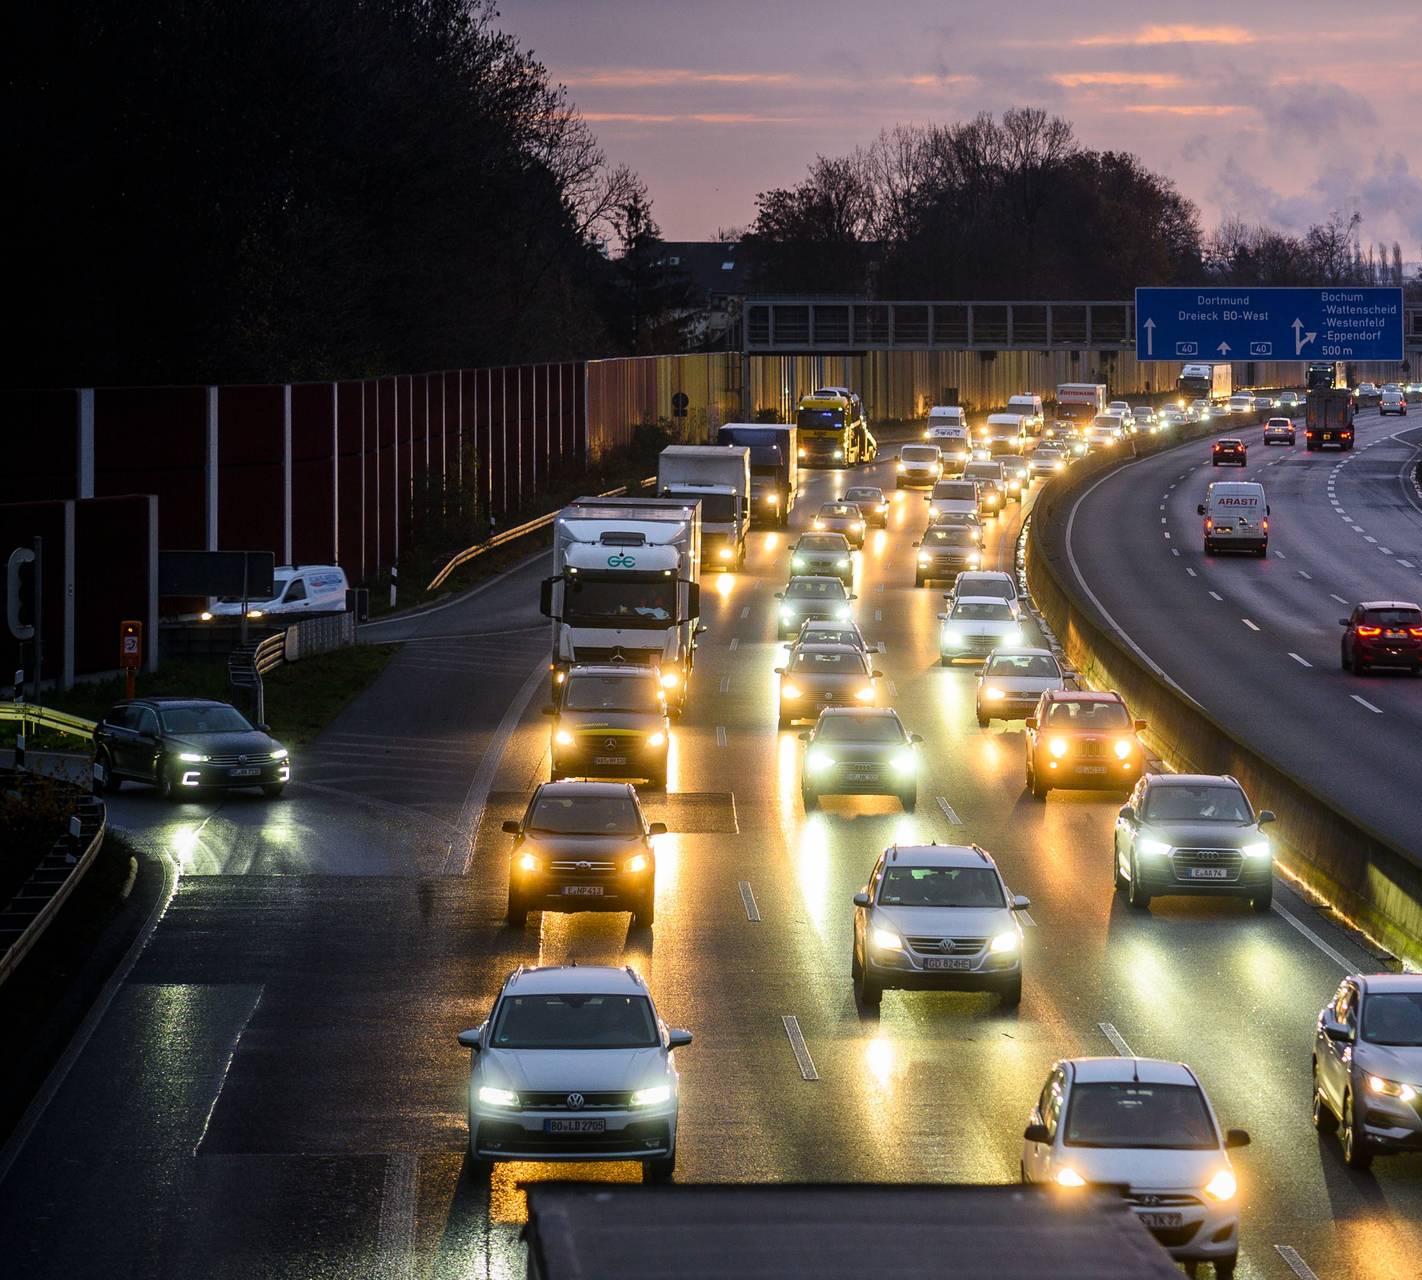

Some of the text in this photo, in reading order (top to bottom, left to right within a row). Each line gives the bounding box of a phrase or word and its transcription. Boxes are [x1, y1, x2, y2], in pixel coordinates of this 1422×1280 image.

[1197, 295, 1250, 305] Dortmund
[1321, 292, 1363, 302] Bochum
[1322, 304, 1397, 315] -Wattenscheid
[1178, 310, 1269, 321] Dreieck BO-West
[1322, 317, 1385, 328] -Westenfeld
[1322, 330, 1381, 342] -Eppendorf
[1181, 344, 1193, 353] 40
[1256, 344, 1267, 353] 40
[1322, 345, 1353, 356] 500 m
[1218, 498, 1258, 506] ARASTI
